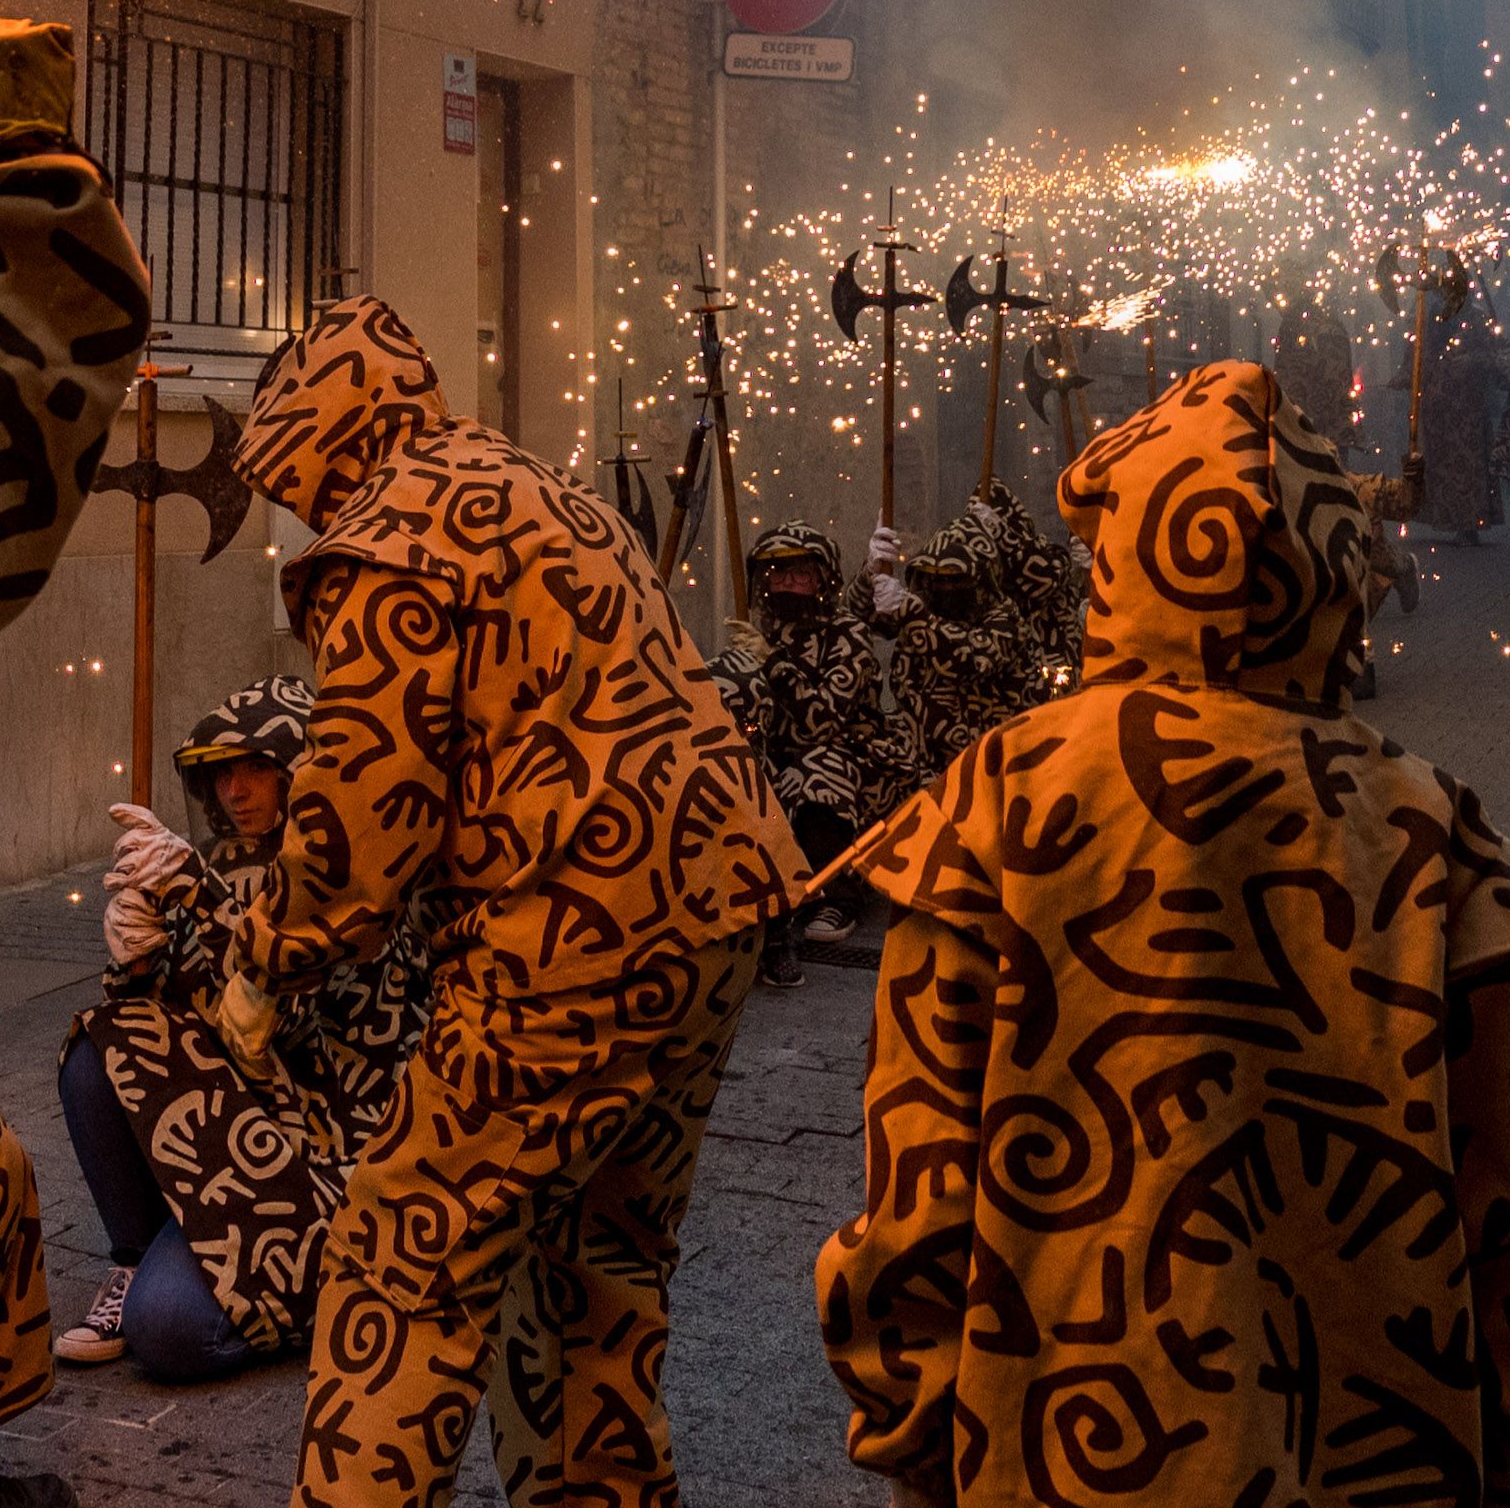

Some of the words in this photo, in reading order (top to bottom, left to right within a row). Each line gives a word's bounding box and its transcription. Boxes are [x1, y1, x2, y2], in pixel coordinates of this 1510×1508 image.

[761, 41, 817, 55] EXCEPTE
[733, 57, 802, 72] BICICLETES
[816, 61, 843, 73] VMP
